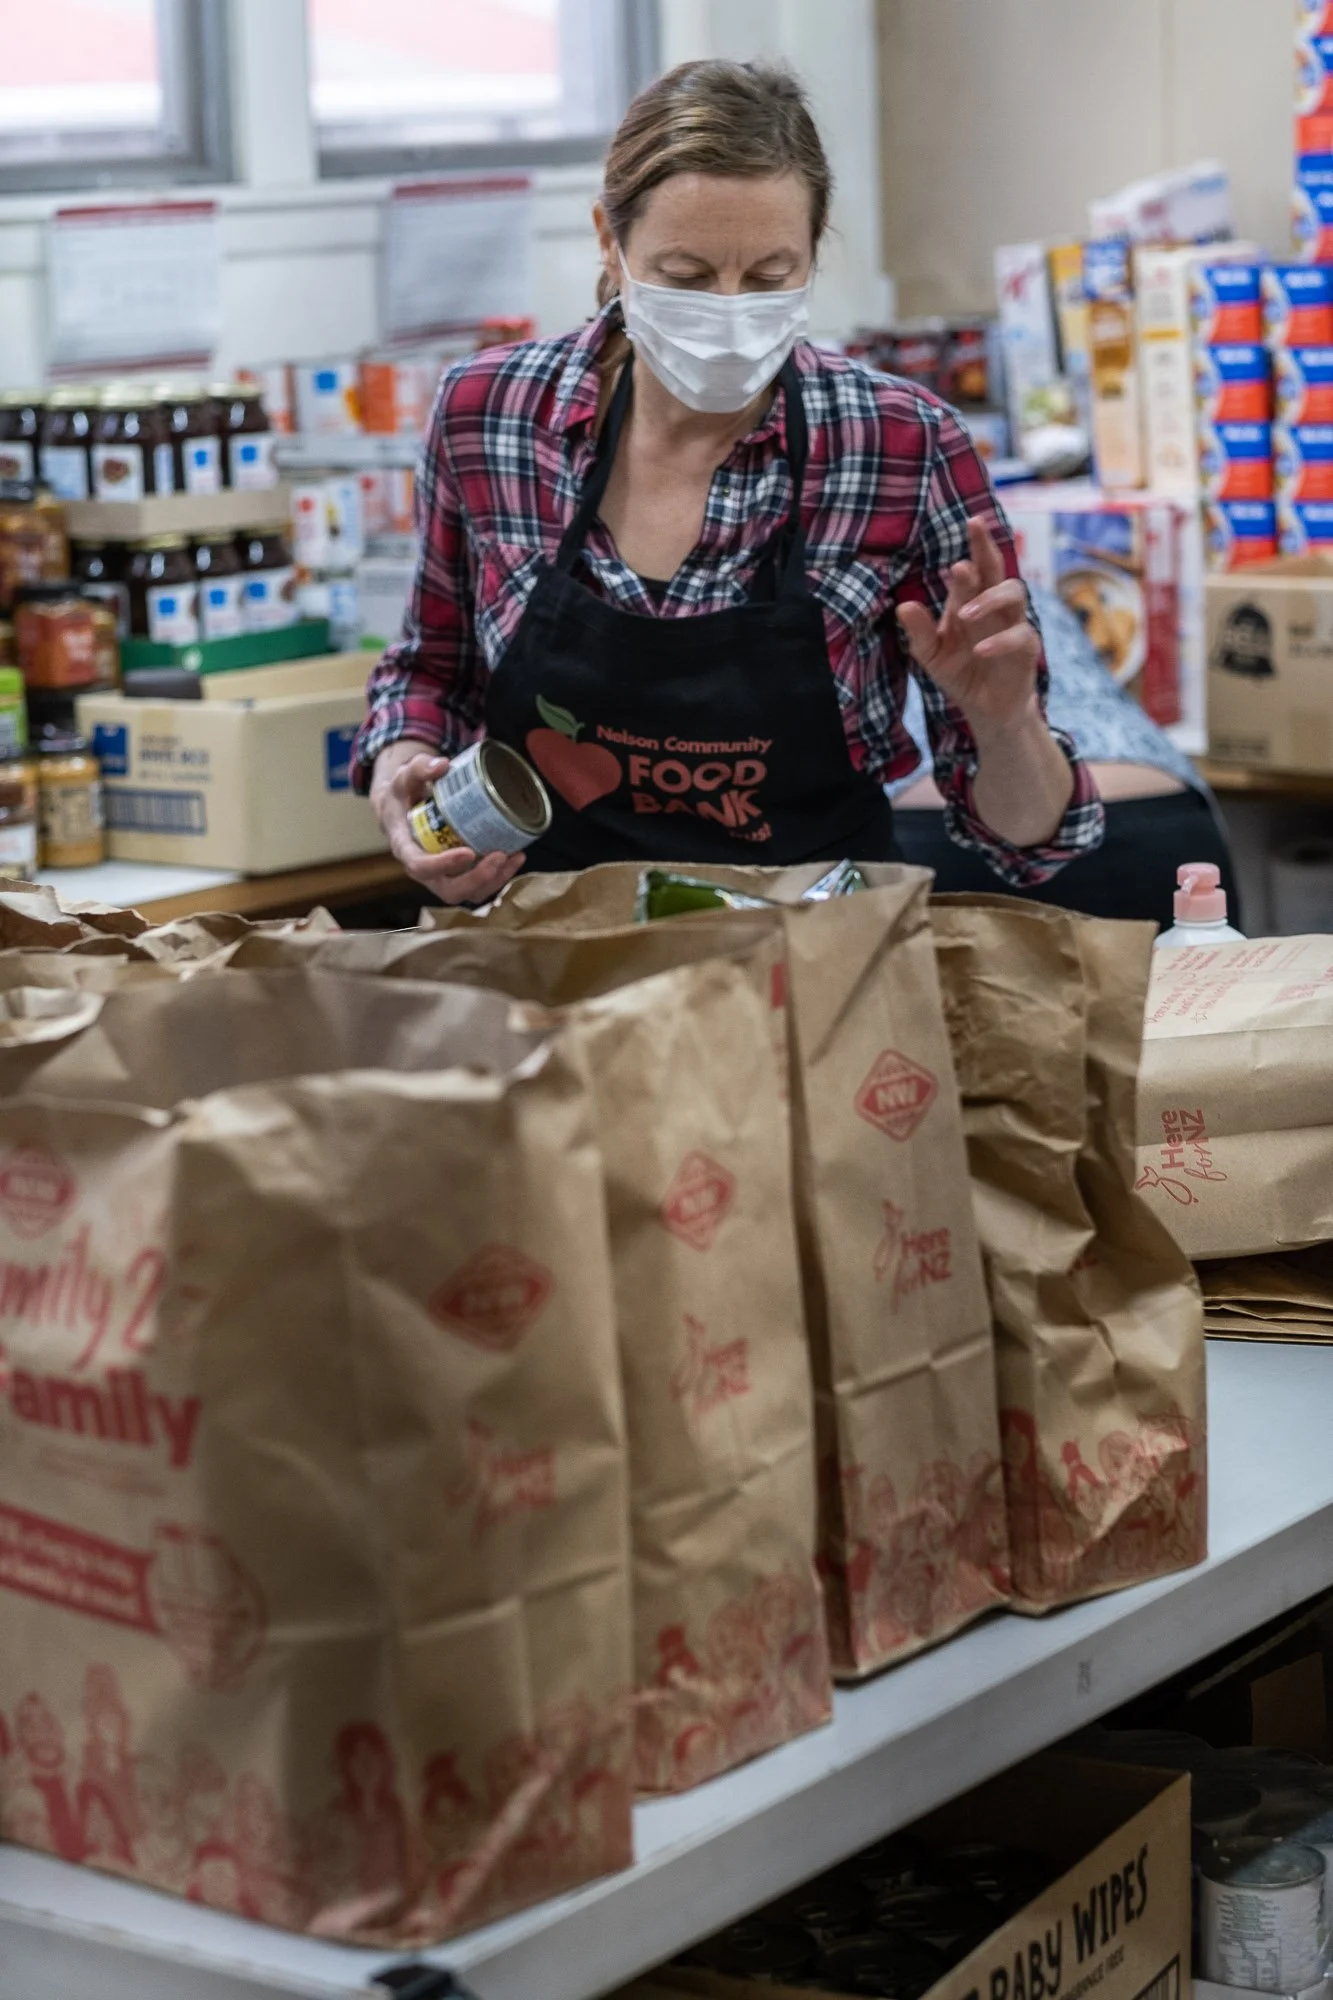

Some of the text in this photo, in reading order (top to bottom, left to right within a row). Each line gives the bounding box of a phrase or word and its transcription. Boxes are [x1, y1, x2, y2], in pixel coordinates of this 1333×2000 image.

[596, 724, 773, 755] Nelson Community
[628, 753, 767, 793] FOOD
[631, 788, 763, 828] BANK
[1160, 1109, 1185, 1169] Here
[1179, 1108, 1228, 1181] for NZ
[1072, 1842, 1148, 1964] WIPES
